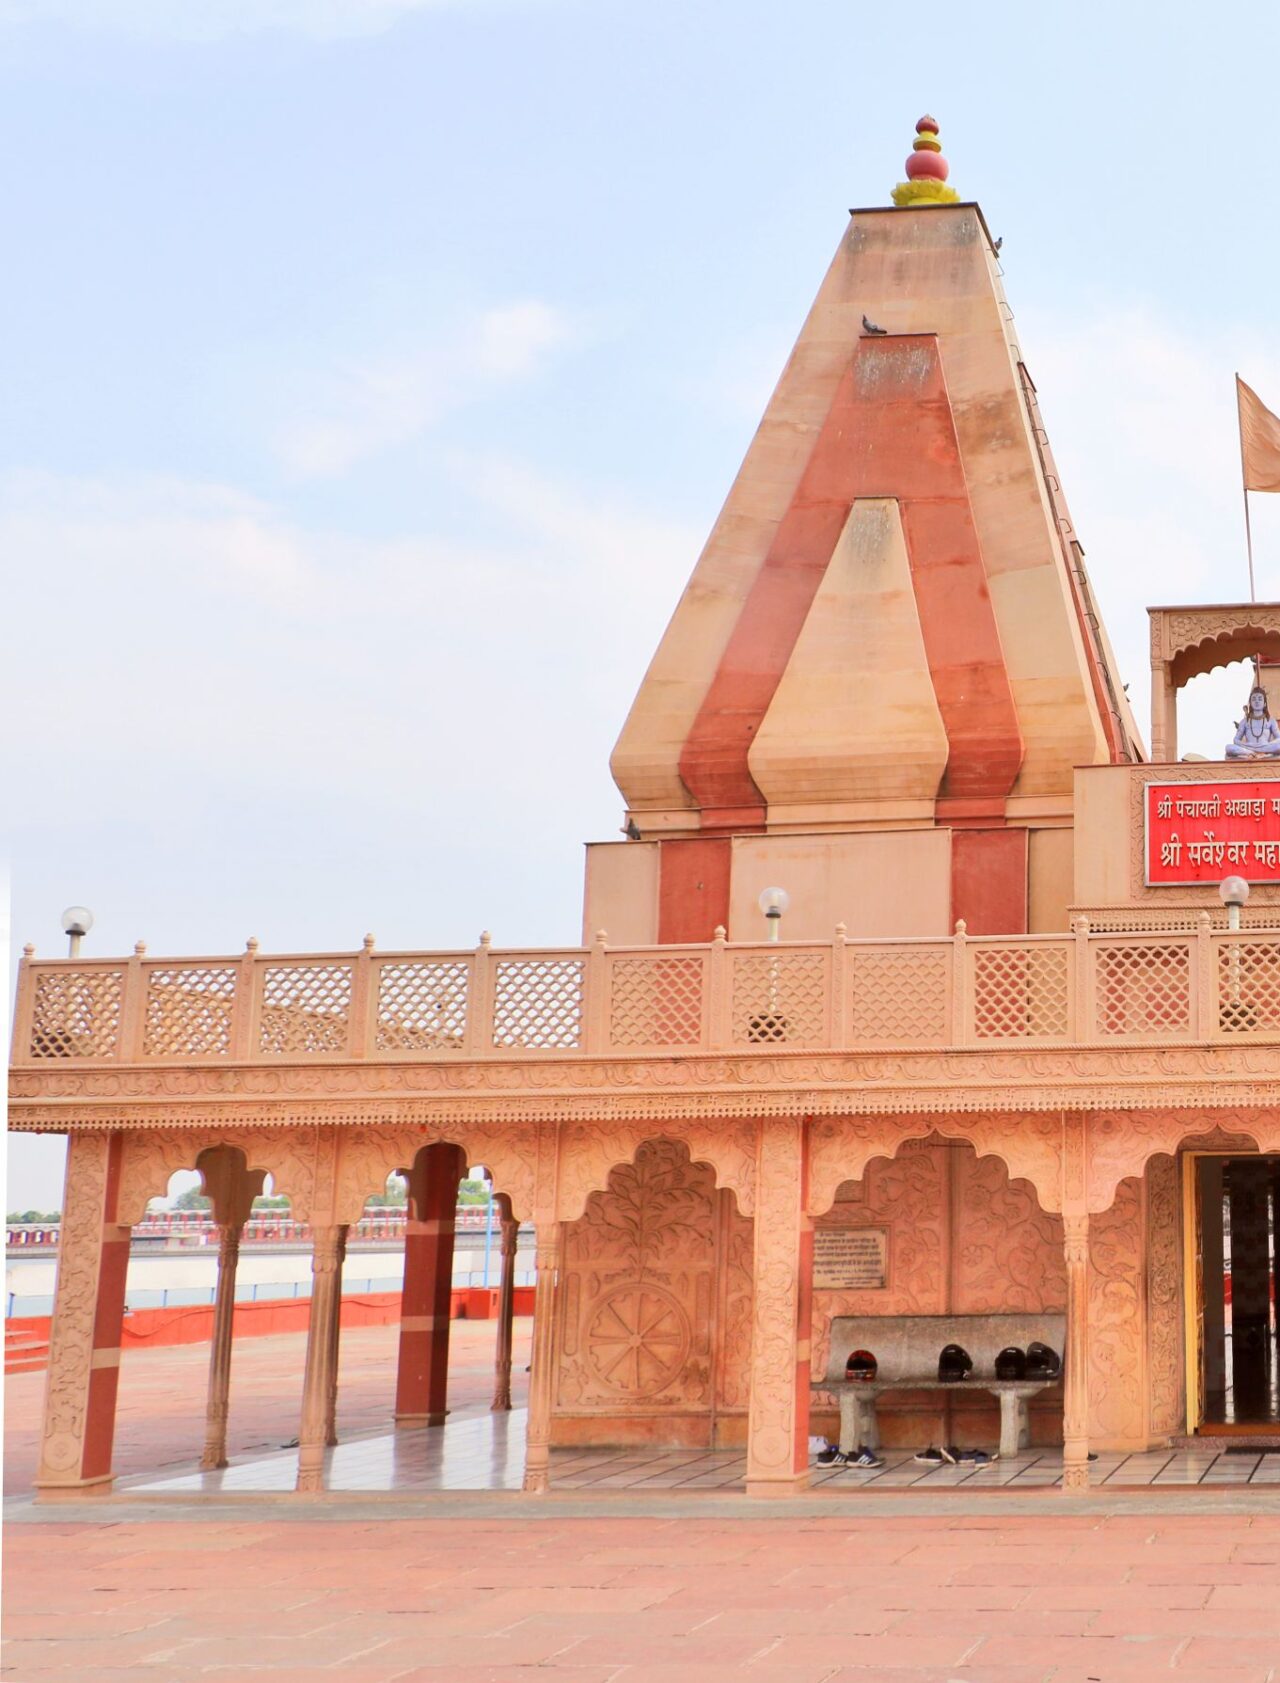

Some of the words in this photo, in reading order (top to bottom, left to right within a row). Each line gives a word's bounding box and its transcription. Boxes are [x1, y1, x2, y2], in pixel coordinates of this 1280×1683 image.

[1157, 795, 1173, 819] श्री
[1176, 793, 1221, 818] पंचायती
[1224, 799, 1265, 821] अखाड़ा
[1161, 833, 1182, 867] श्री
[1187, 831, 1249, 868] सर्वेश्वर
